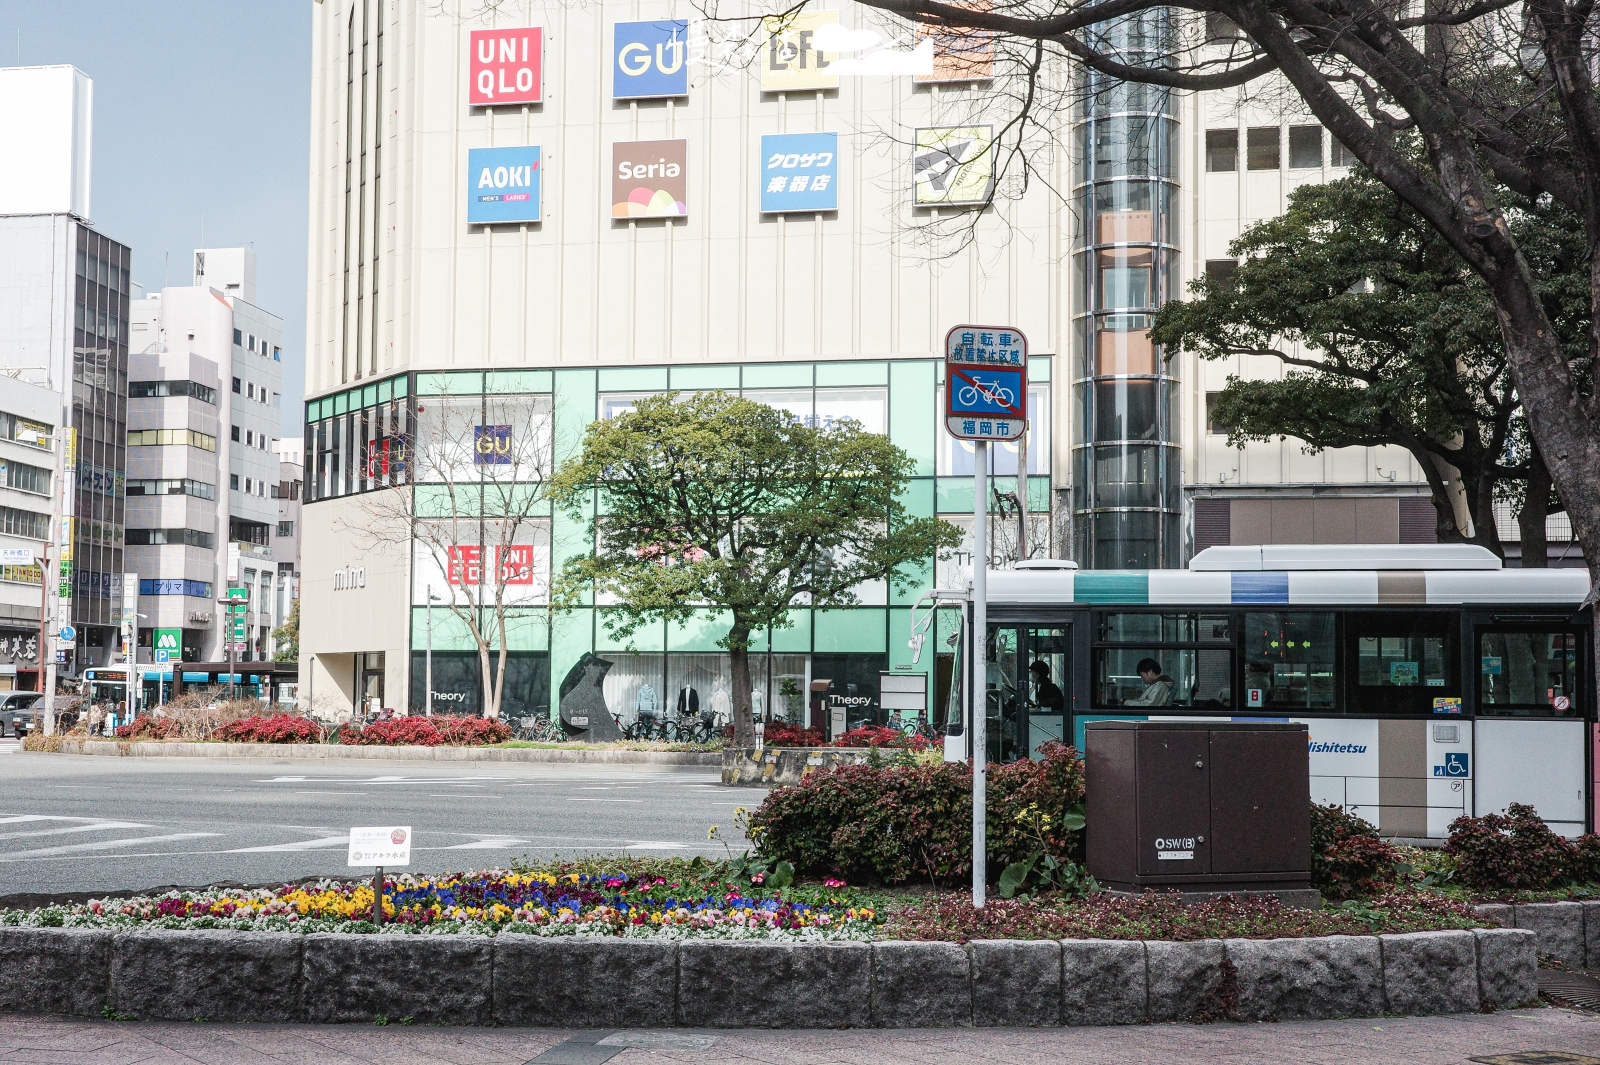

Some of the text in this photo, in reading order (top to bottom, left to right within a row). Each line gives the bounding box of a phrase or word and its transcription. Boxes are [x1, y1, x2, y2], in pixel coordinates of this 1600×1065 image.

[478, 37, 529, 64] UNI
[618, 42, 683, 76] GU
[477, 68, 533, 98] QLO
[618, 157, 681, 180] Seria
[767, 153, 833, 169] クロサワ
[478, 165, 531, 189] AOKI
[766, 174, 831, 194] 楽器店
[962, 332, 1012, 347] 自転車
[953, 347, 1020, 364] 放置禁止区域
[963, 420, 1009, 436] 福岡市
[476, 436, 510, 454] GU
[159, 650, 167, 662] P
[829, 694, 871, 706] Theory
